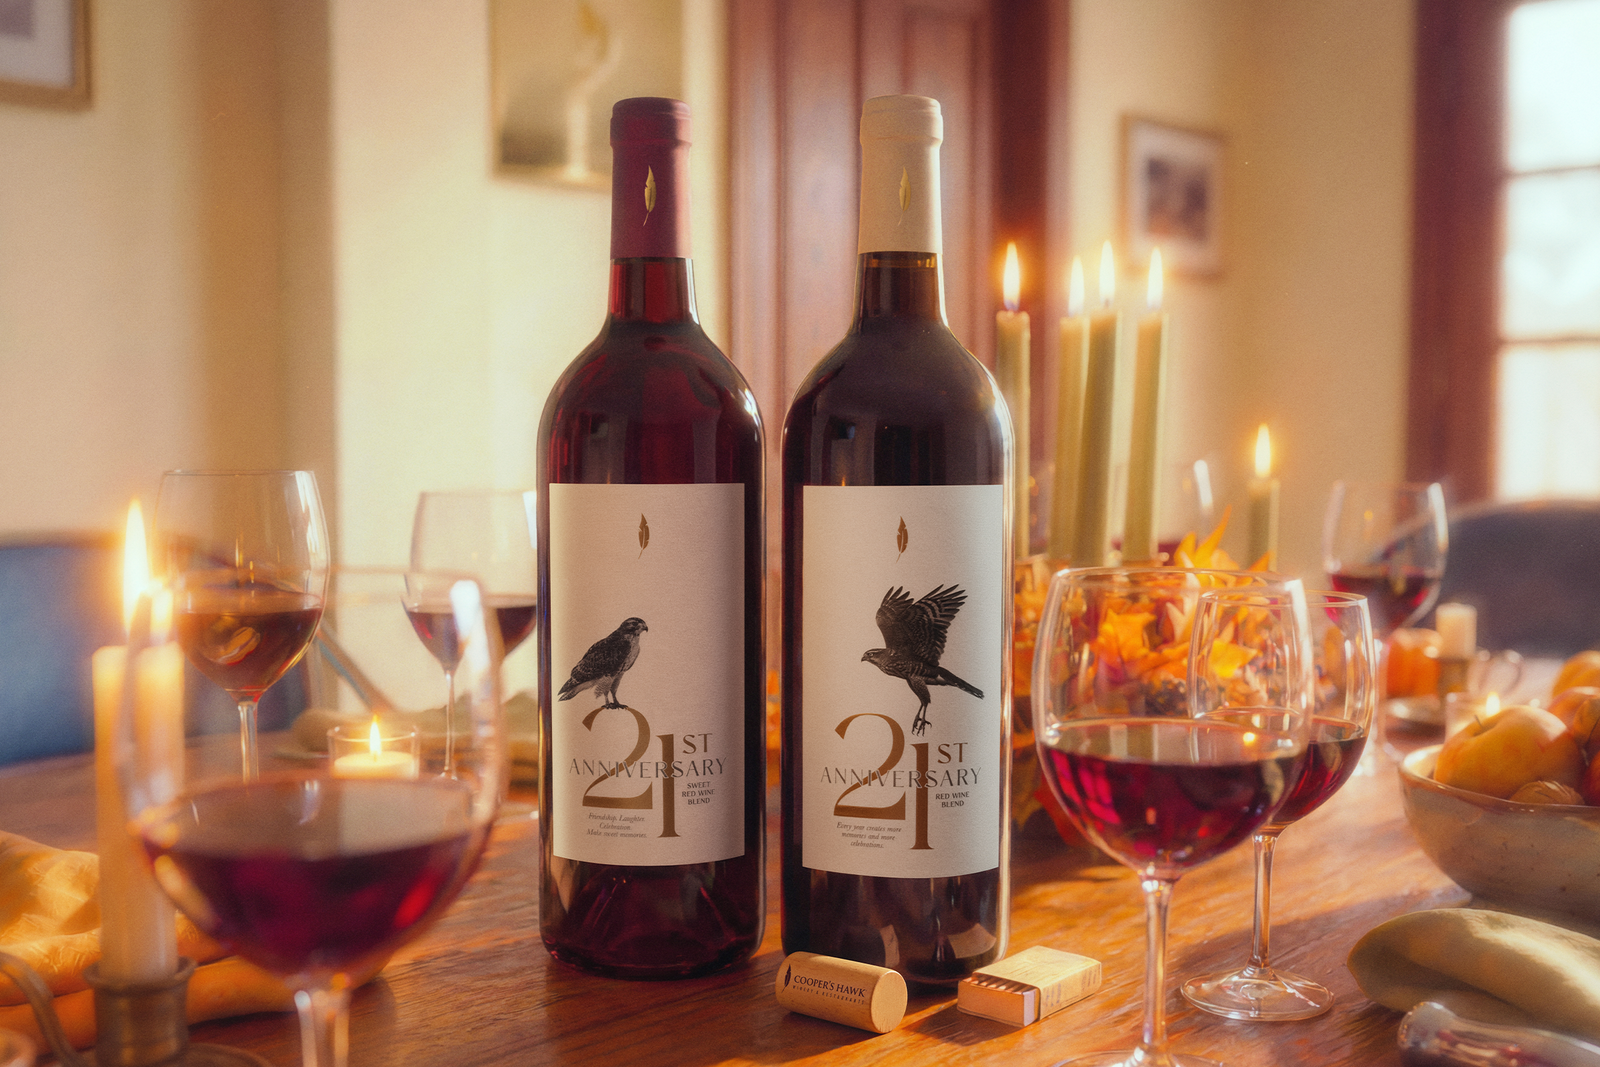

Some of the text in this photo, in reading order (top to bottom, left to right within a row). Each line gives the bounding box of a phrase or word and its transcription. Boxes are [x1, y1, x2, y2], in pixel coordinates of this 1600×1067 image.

[569, 757, 727, 778] ANNIVERSARY
[821, 767, 981, 788] ANNIVERSARY
[687, 781, 711, 789] SWEET
[951, 791, 970, 799] WINE
[688, 797, 710, 805] BLEND
[941, 800, 965, 808] BLEND
[836, 821, 852, 831] Every
[586, 828, 602, 836] Make
[794, 975, 866, 998] COOPER'S HAWK
